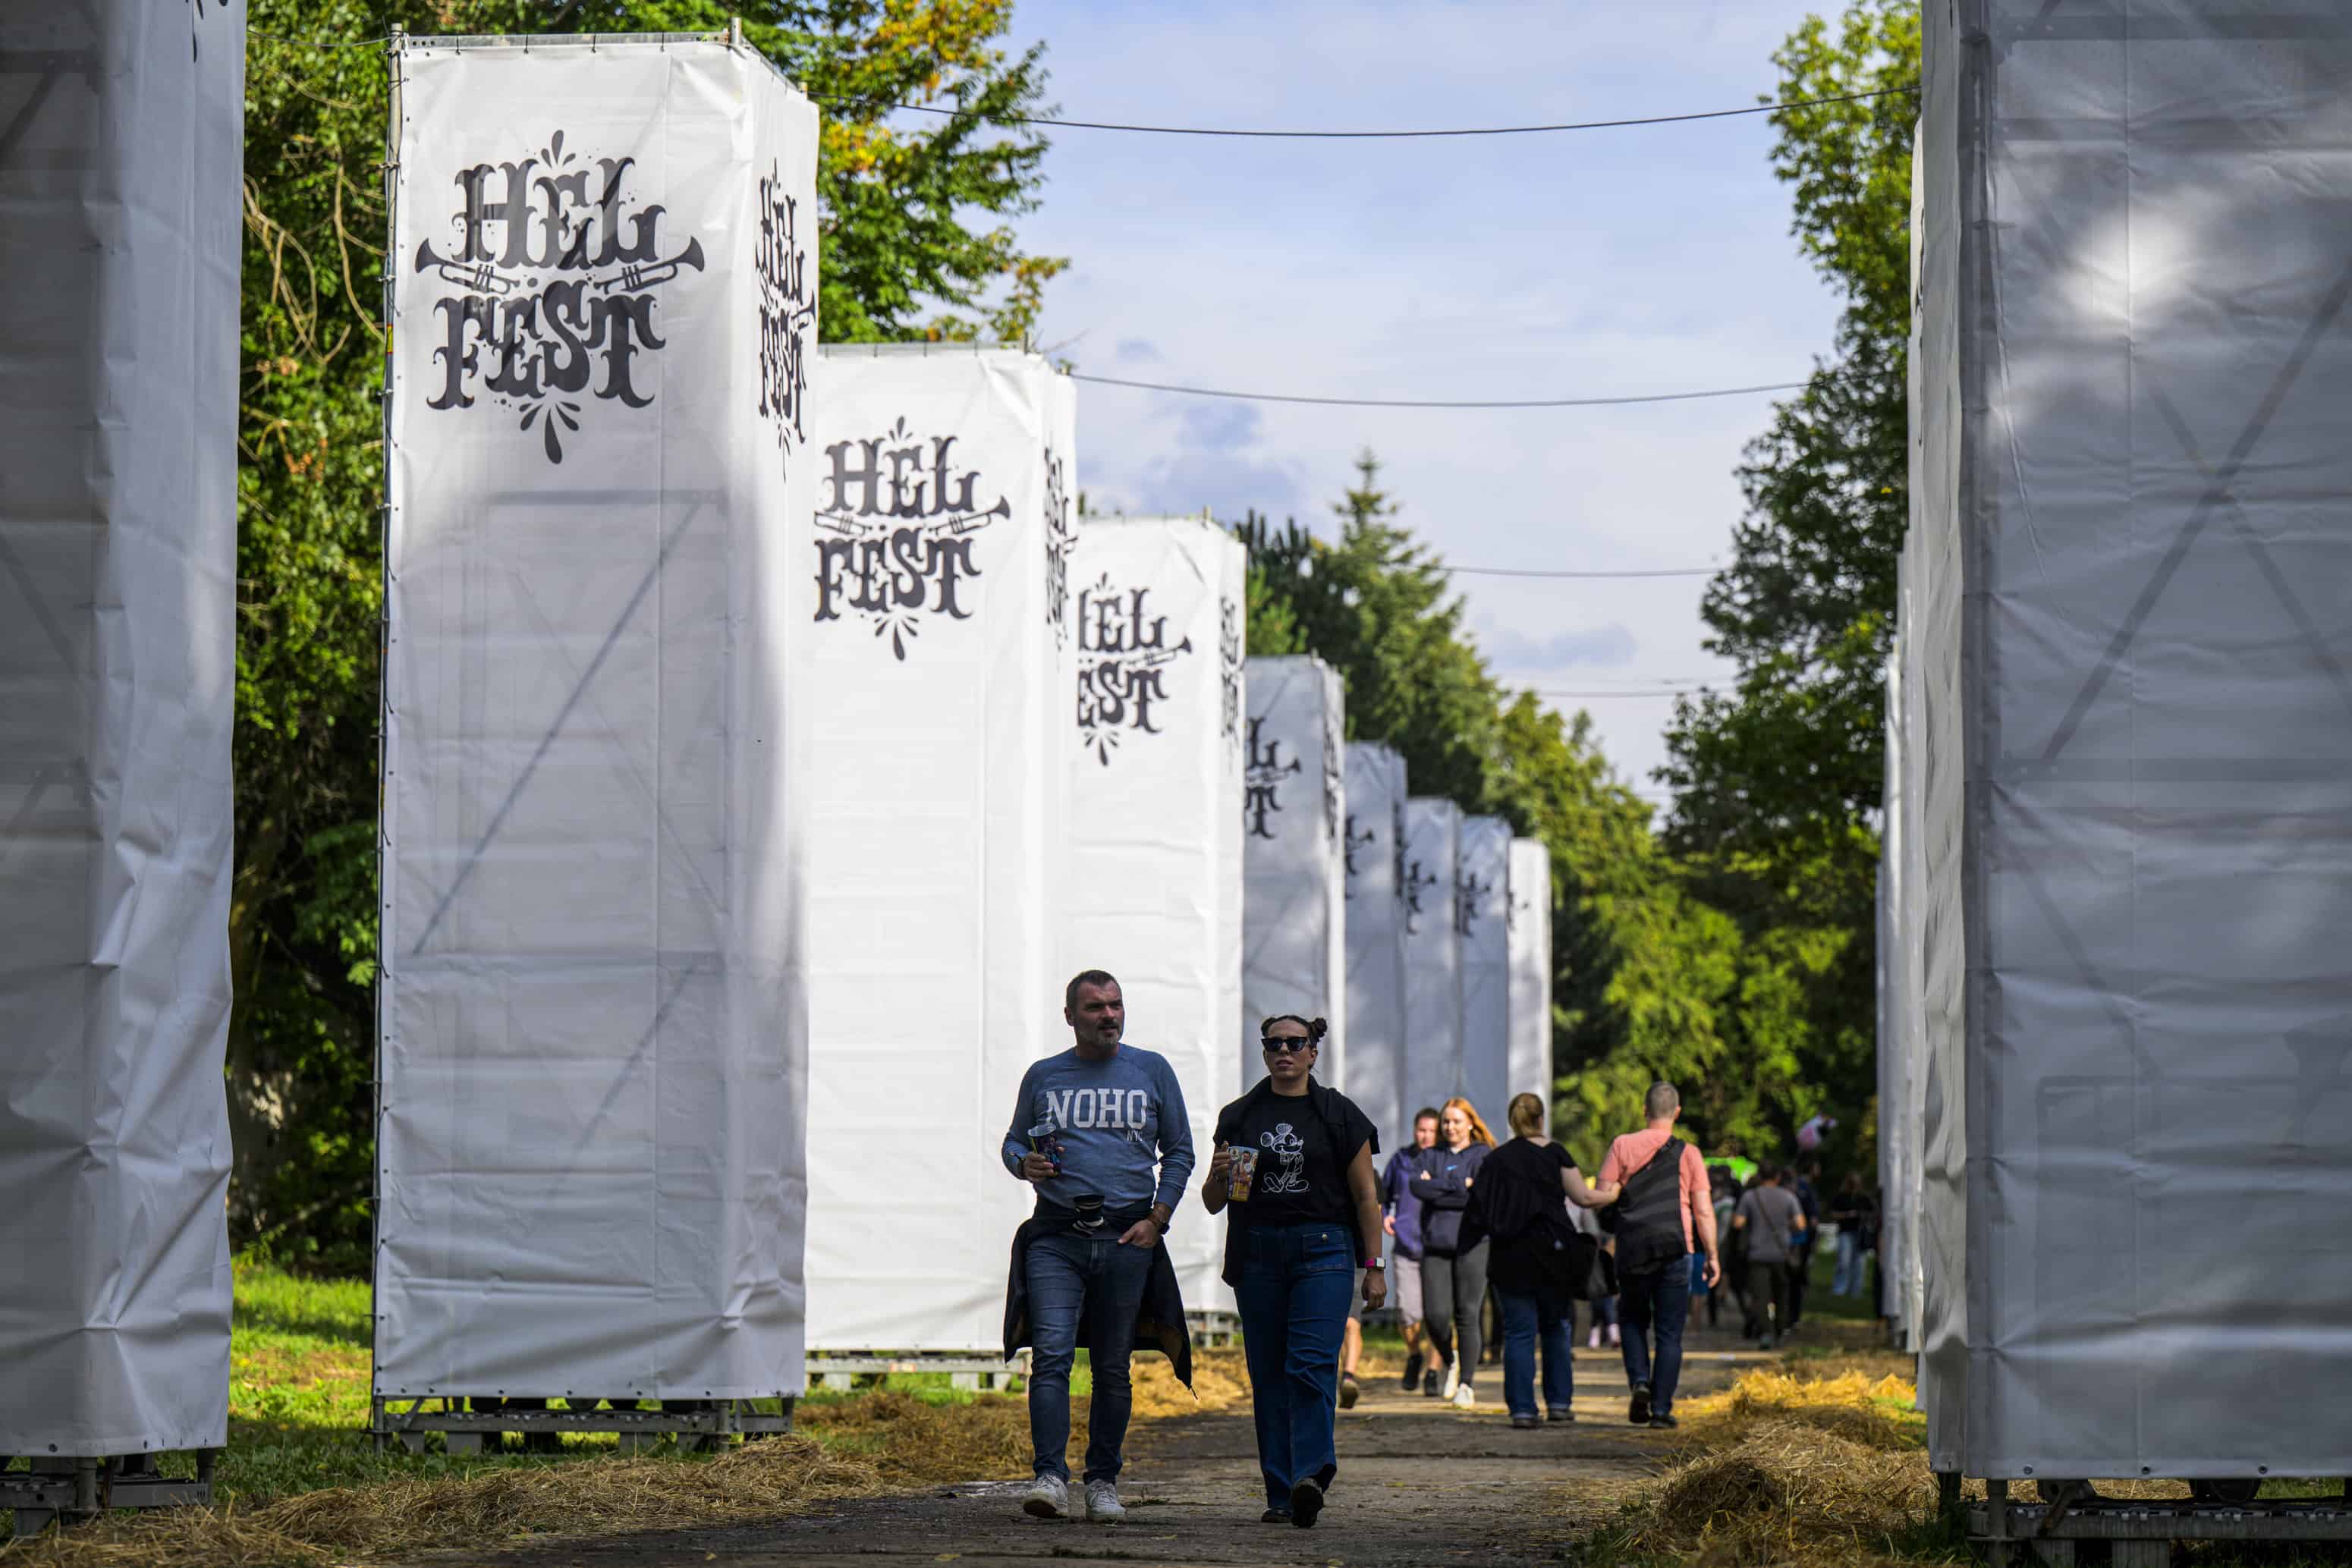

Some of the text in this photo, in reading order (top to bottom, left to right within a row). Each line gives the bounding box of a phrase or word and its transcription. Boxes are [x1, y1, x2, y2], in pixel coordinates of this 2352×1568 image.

[451, 156, 667, 270] HEL
[426, 279, 666, 410] FEST
[822, 435, 981, 518] HEL
[813, 526, 982, 621] FEST
[1077, 660, 1169, 735] EST
[1046, 1088, 1148, 1130] NOHO
